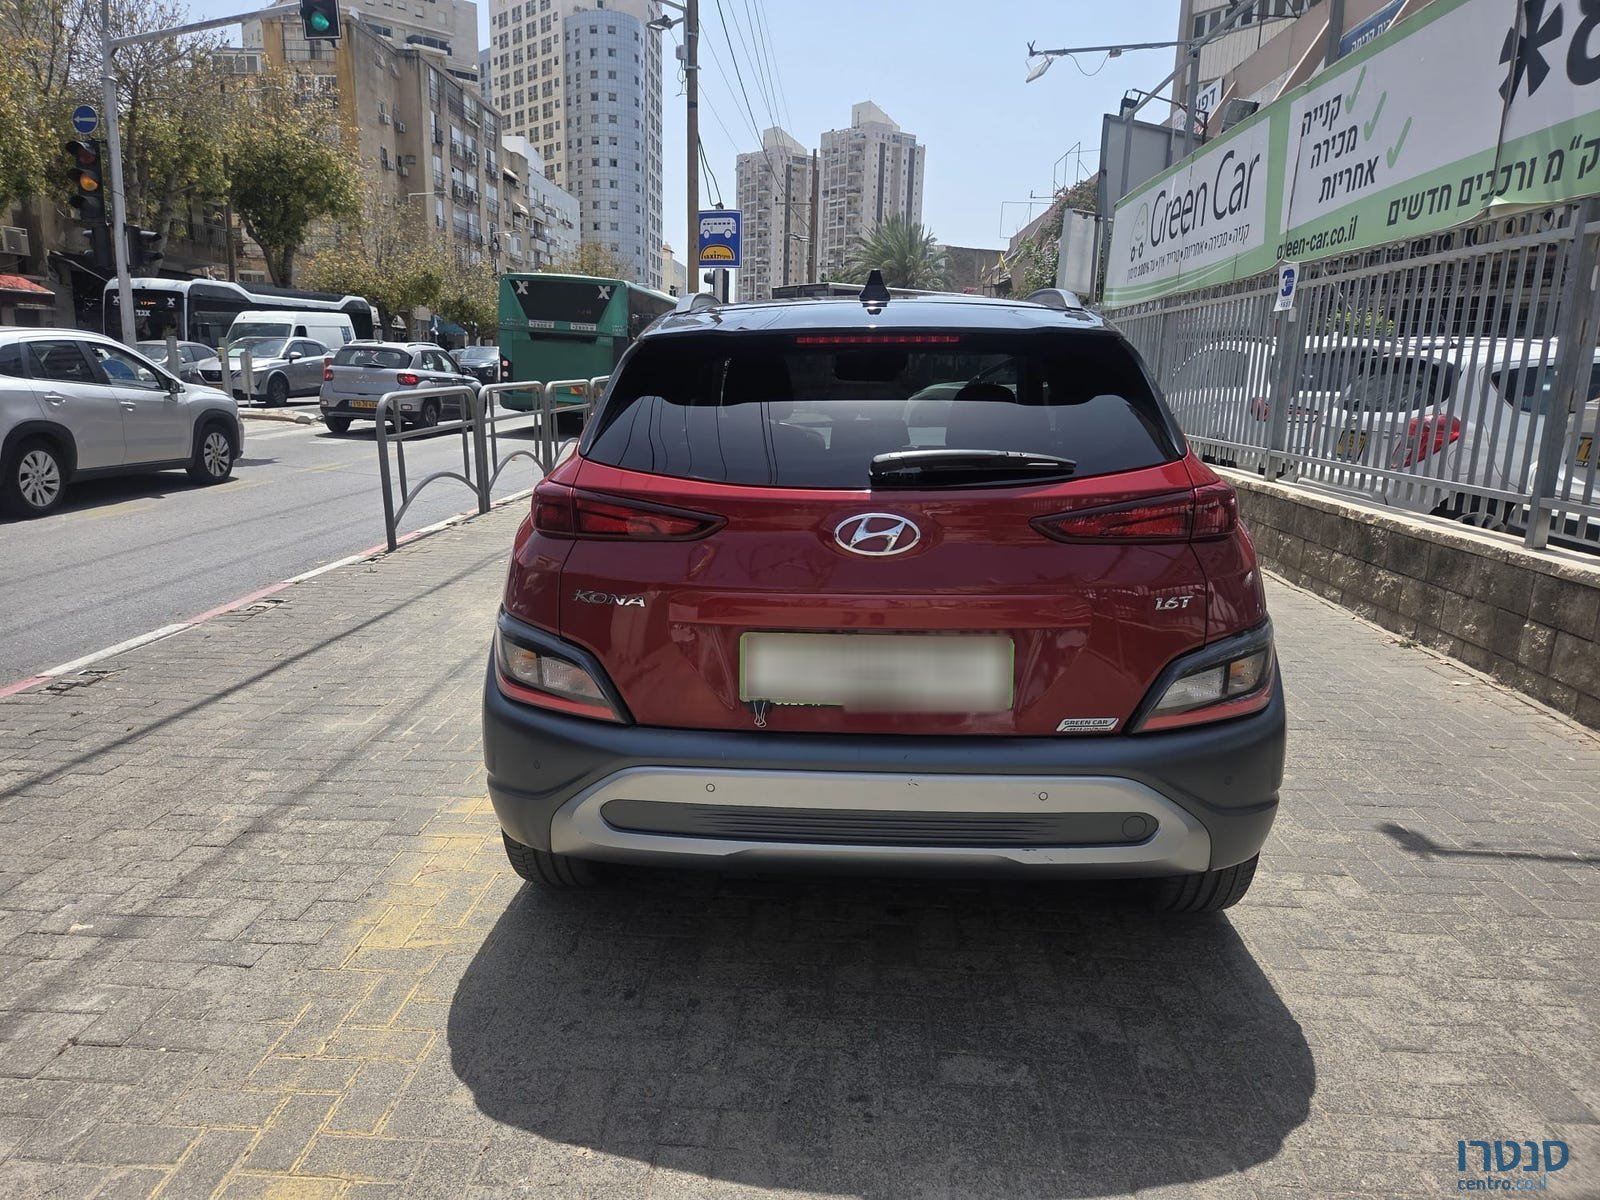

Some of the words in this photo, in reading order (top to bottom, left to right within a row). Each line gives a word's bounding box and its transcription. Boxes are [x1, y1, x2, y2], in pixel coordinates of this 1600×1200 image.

[1301, 94, 1343, 137] קנייה
[1311, 125, 1358, 169] מכירה
[1150, 181, 1207, 247] Green
[1213, 150, 1260, 220] Car
[1318, 156, 1379, 204] אחריות
[1457, 157, 1537, 207] ורכבים
[1386, 183, 1452, 227] חדשים
[574, 589, 646, 607] KONA
